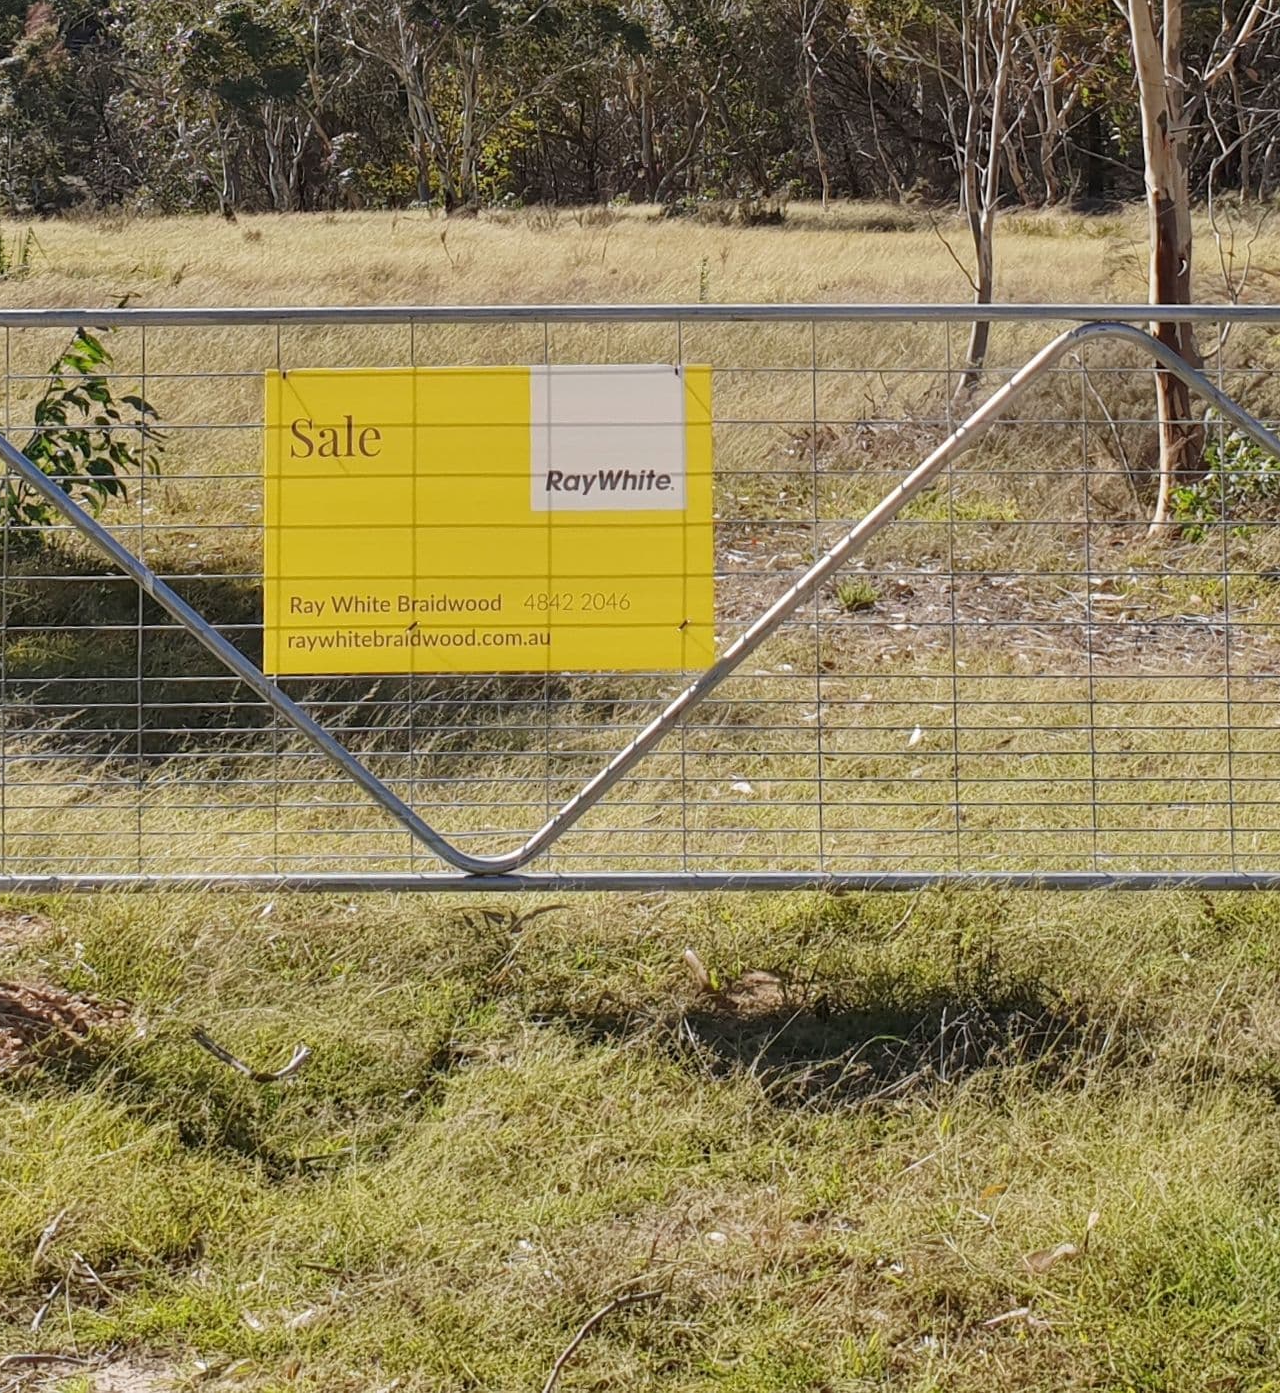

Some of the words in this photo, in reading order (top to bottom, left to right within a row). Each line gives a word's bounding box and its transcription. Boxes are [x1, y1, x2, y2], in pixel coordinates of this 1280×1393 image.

[290, 415, 382, 458] Sale
[290, 596, 325, 616] Ray
[331, 595, 391, 613] White
[397, 594, 502, 612] Braidwood
[524, 593, 574, 611] 4842
[581, 592, 631, 610] 2046
[288, 628, 551, 652] raywhitebraidwood.com.au
